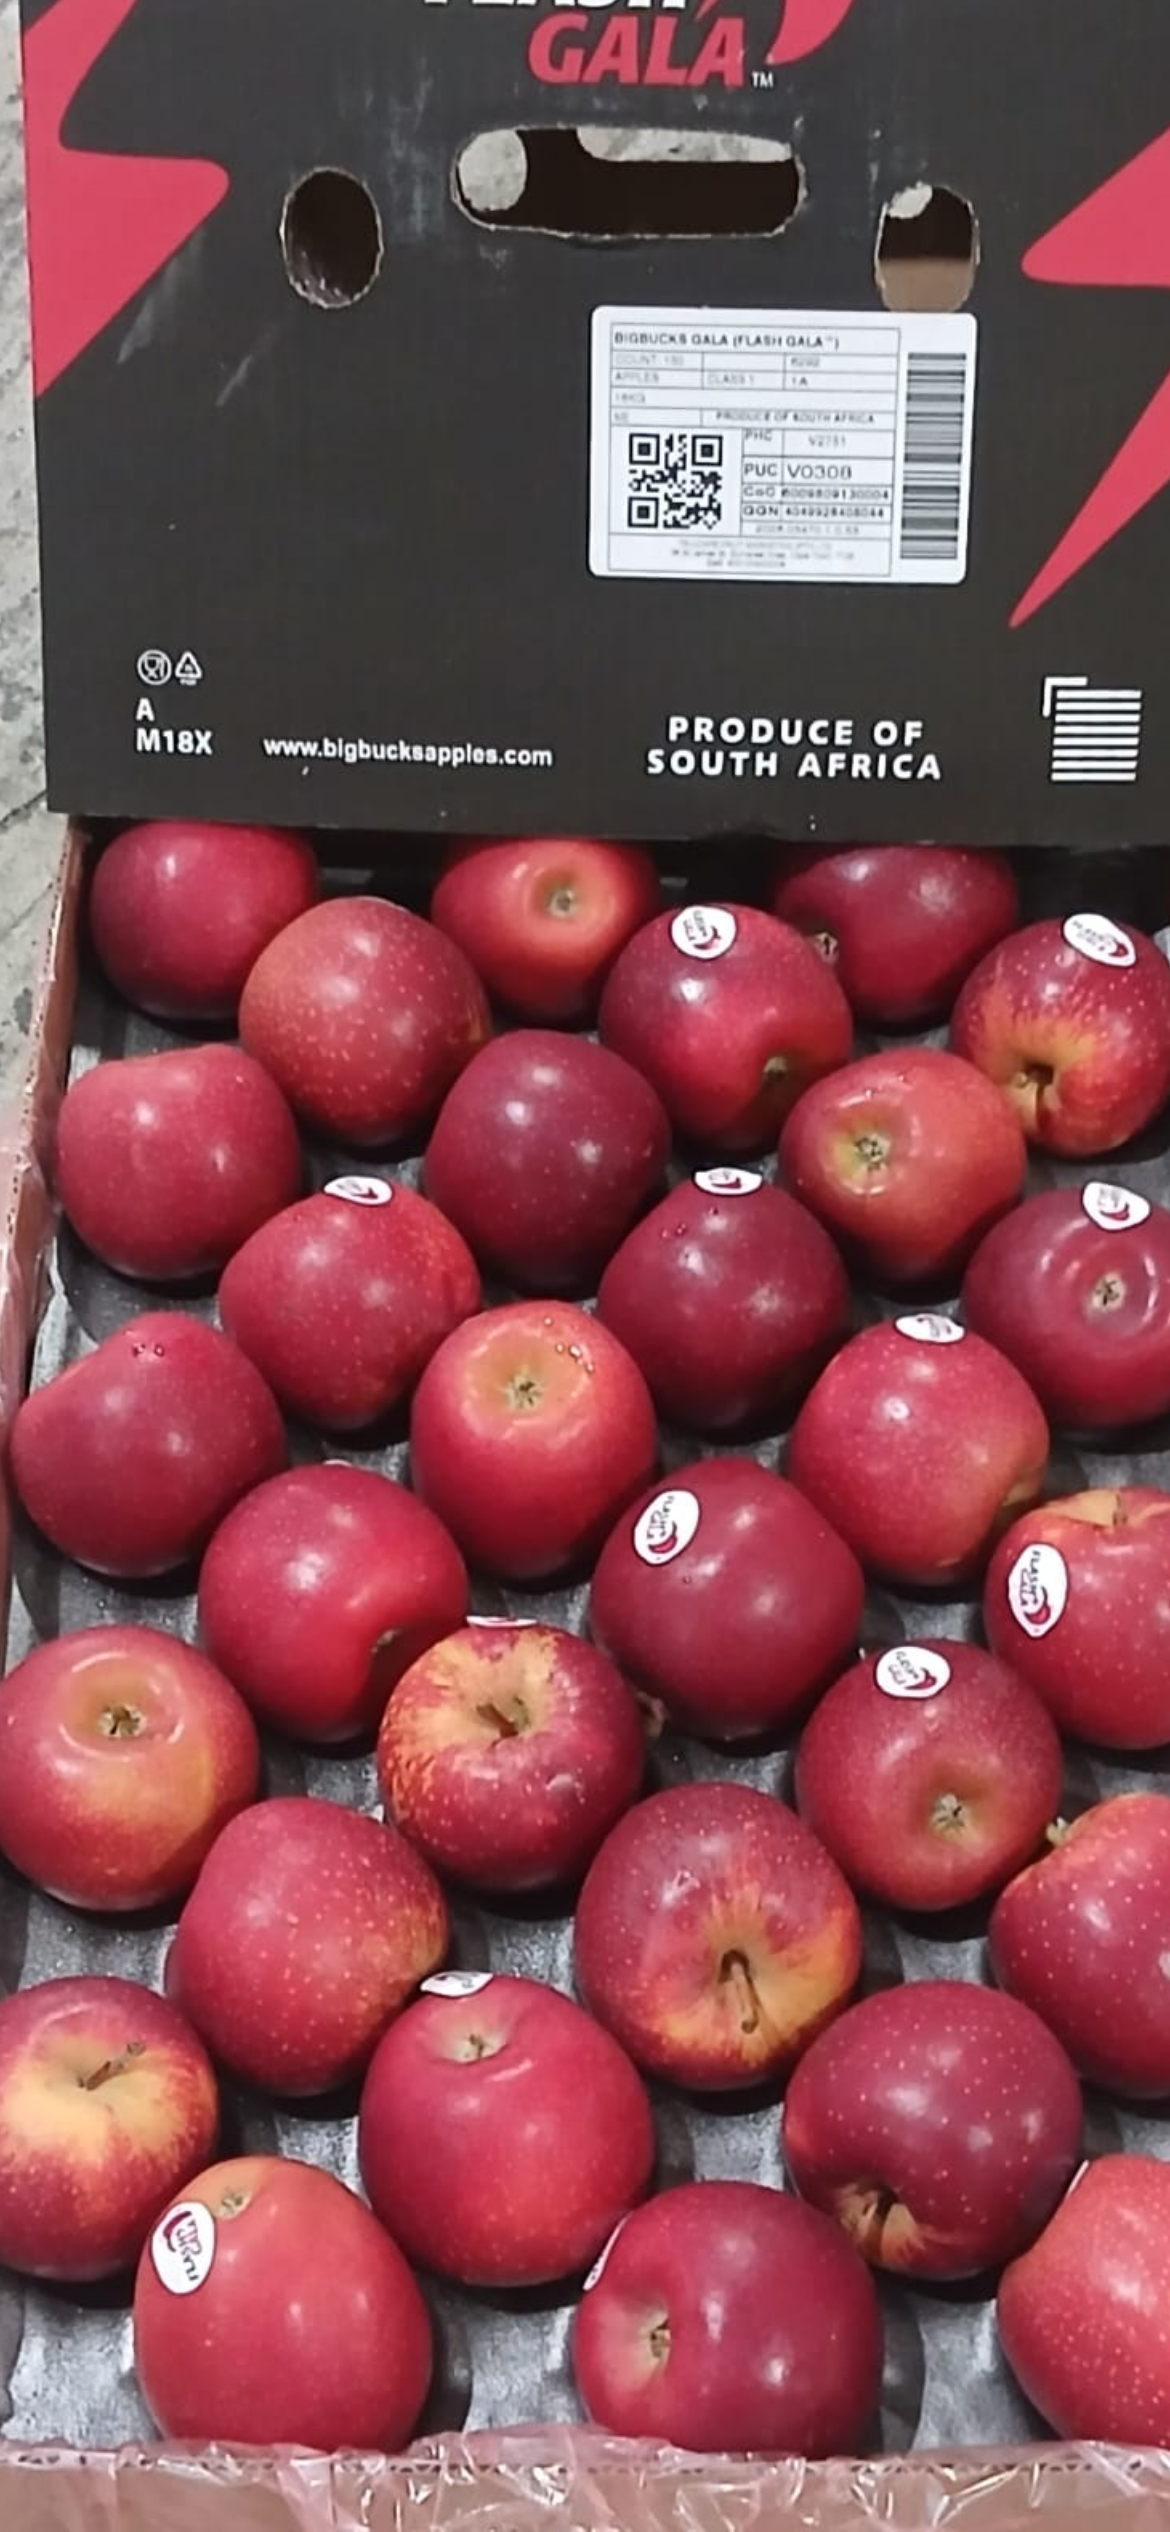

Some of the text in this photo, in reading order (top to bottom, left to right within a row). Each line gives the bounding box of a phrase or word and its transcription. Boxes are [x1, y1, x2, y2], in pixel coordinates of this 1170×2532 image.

[528, 13, 745, 87] GALA
[614, 332, 687, 346] BIGBUCKS
[691, 335, 728, 347] GALA
[716, 411, 770, 422] PRODUCE
[744, 463, 778, 477] PUC
[136, 697, 155, 721] A
[136, 727, 213, 755] M18X
[668, 716, 924, 747] PRODUCE OF
[263, 737, 553, 768] www.bigbucksapples.com
[647, 748, 942, 780] SOUTH AFRICA
